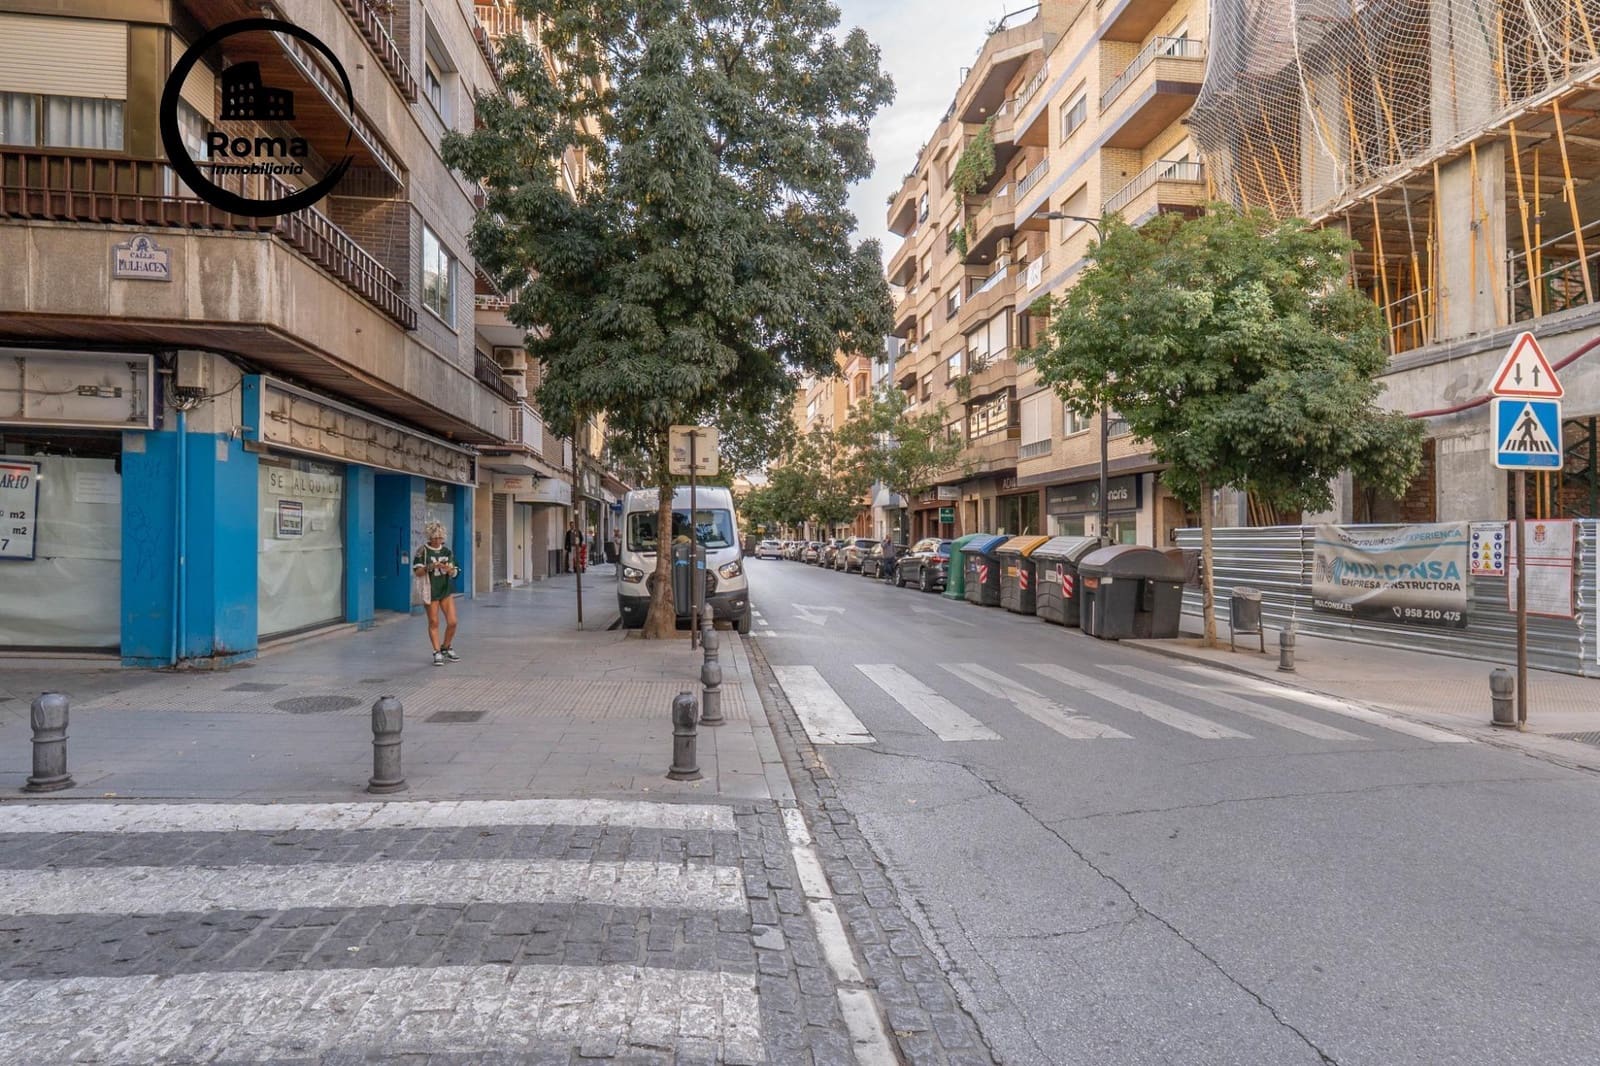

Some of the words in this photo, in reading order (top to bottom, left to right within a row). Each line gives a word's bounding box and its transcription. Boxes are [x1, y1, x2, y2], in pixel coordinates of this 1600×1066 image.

[130, 252, 155, 260] CALLE
[271, 473, 284, 488] SE
[10, 511, 26, 520] m2
[12, 527, 28, 535] m2
[1344, 560, 1461, 581] MULCONSA
[1341, 578, 1381, 590] EMPRESA
[1405, 608, 1422, 617] 958
[1424, 609, 1441, 619] 210
[1443, 611, 1461, 621] 475
